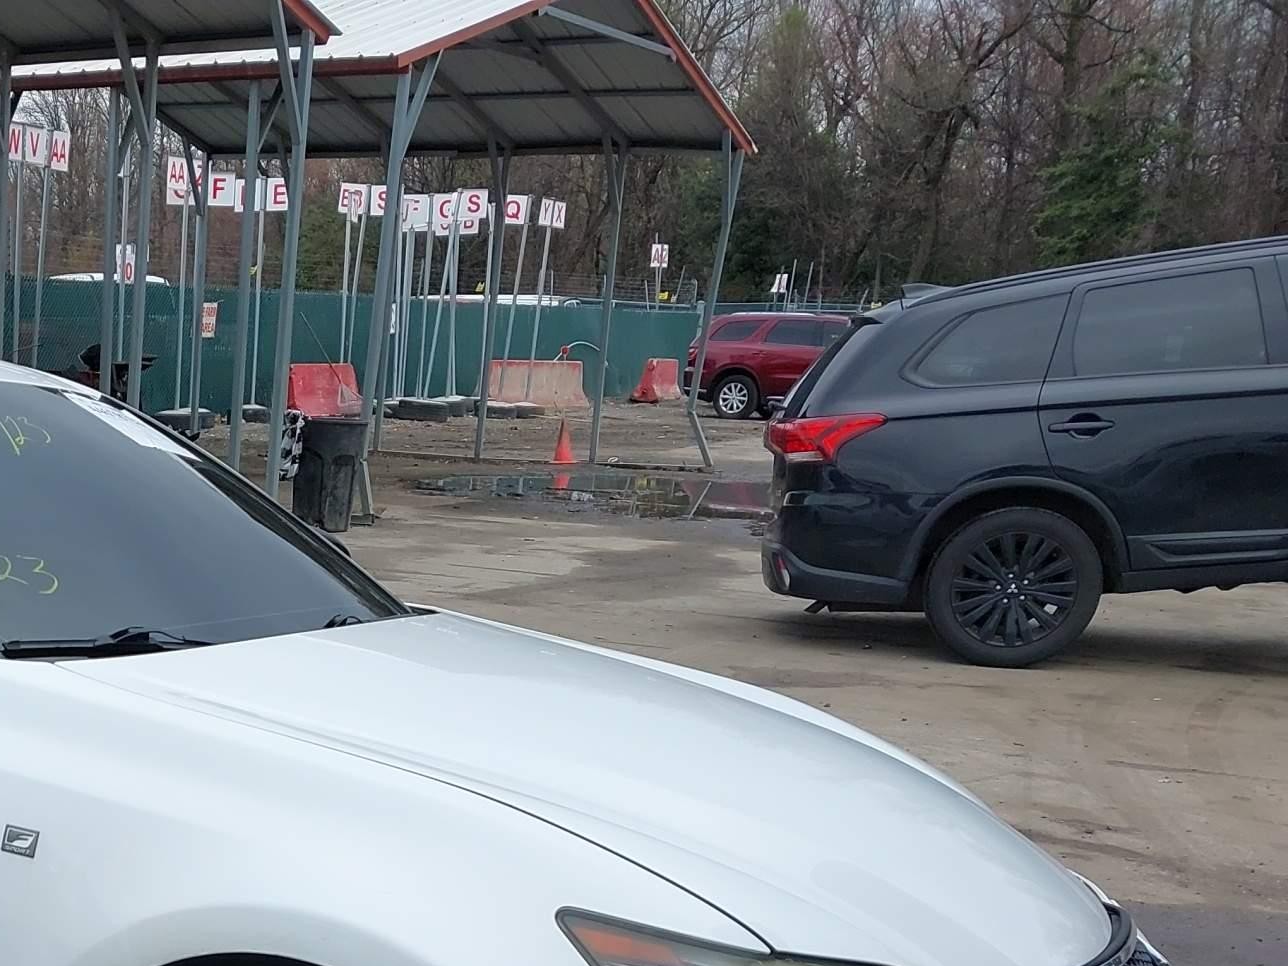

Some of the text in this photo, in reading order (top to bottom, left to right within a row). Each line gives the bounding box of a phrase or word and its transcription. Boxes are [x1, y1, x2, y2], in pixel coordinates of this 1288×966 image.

[30, 131, 40, 157] V
[51, 138, 66, 164] AA
[169, 161, 185, 185] AA
[212, 177, 227, 200] F
[272, 184, 287, 205] E
[467, 194, 481, 213] S
[504, 200, 520, 220] Q
[544, 202, 551, 220] Y
[555, 203, 564, 223] X
